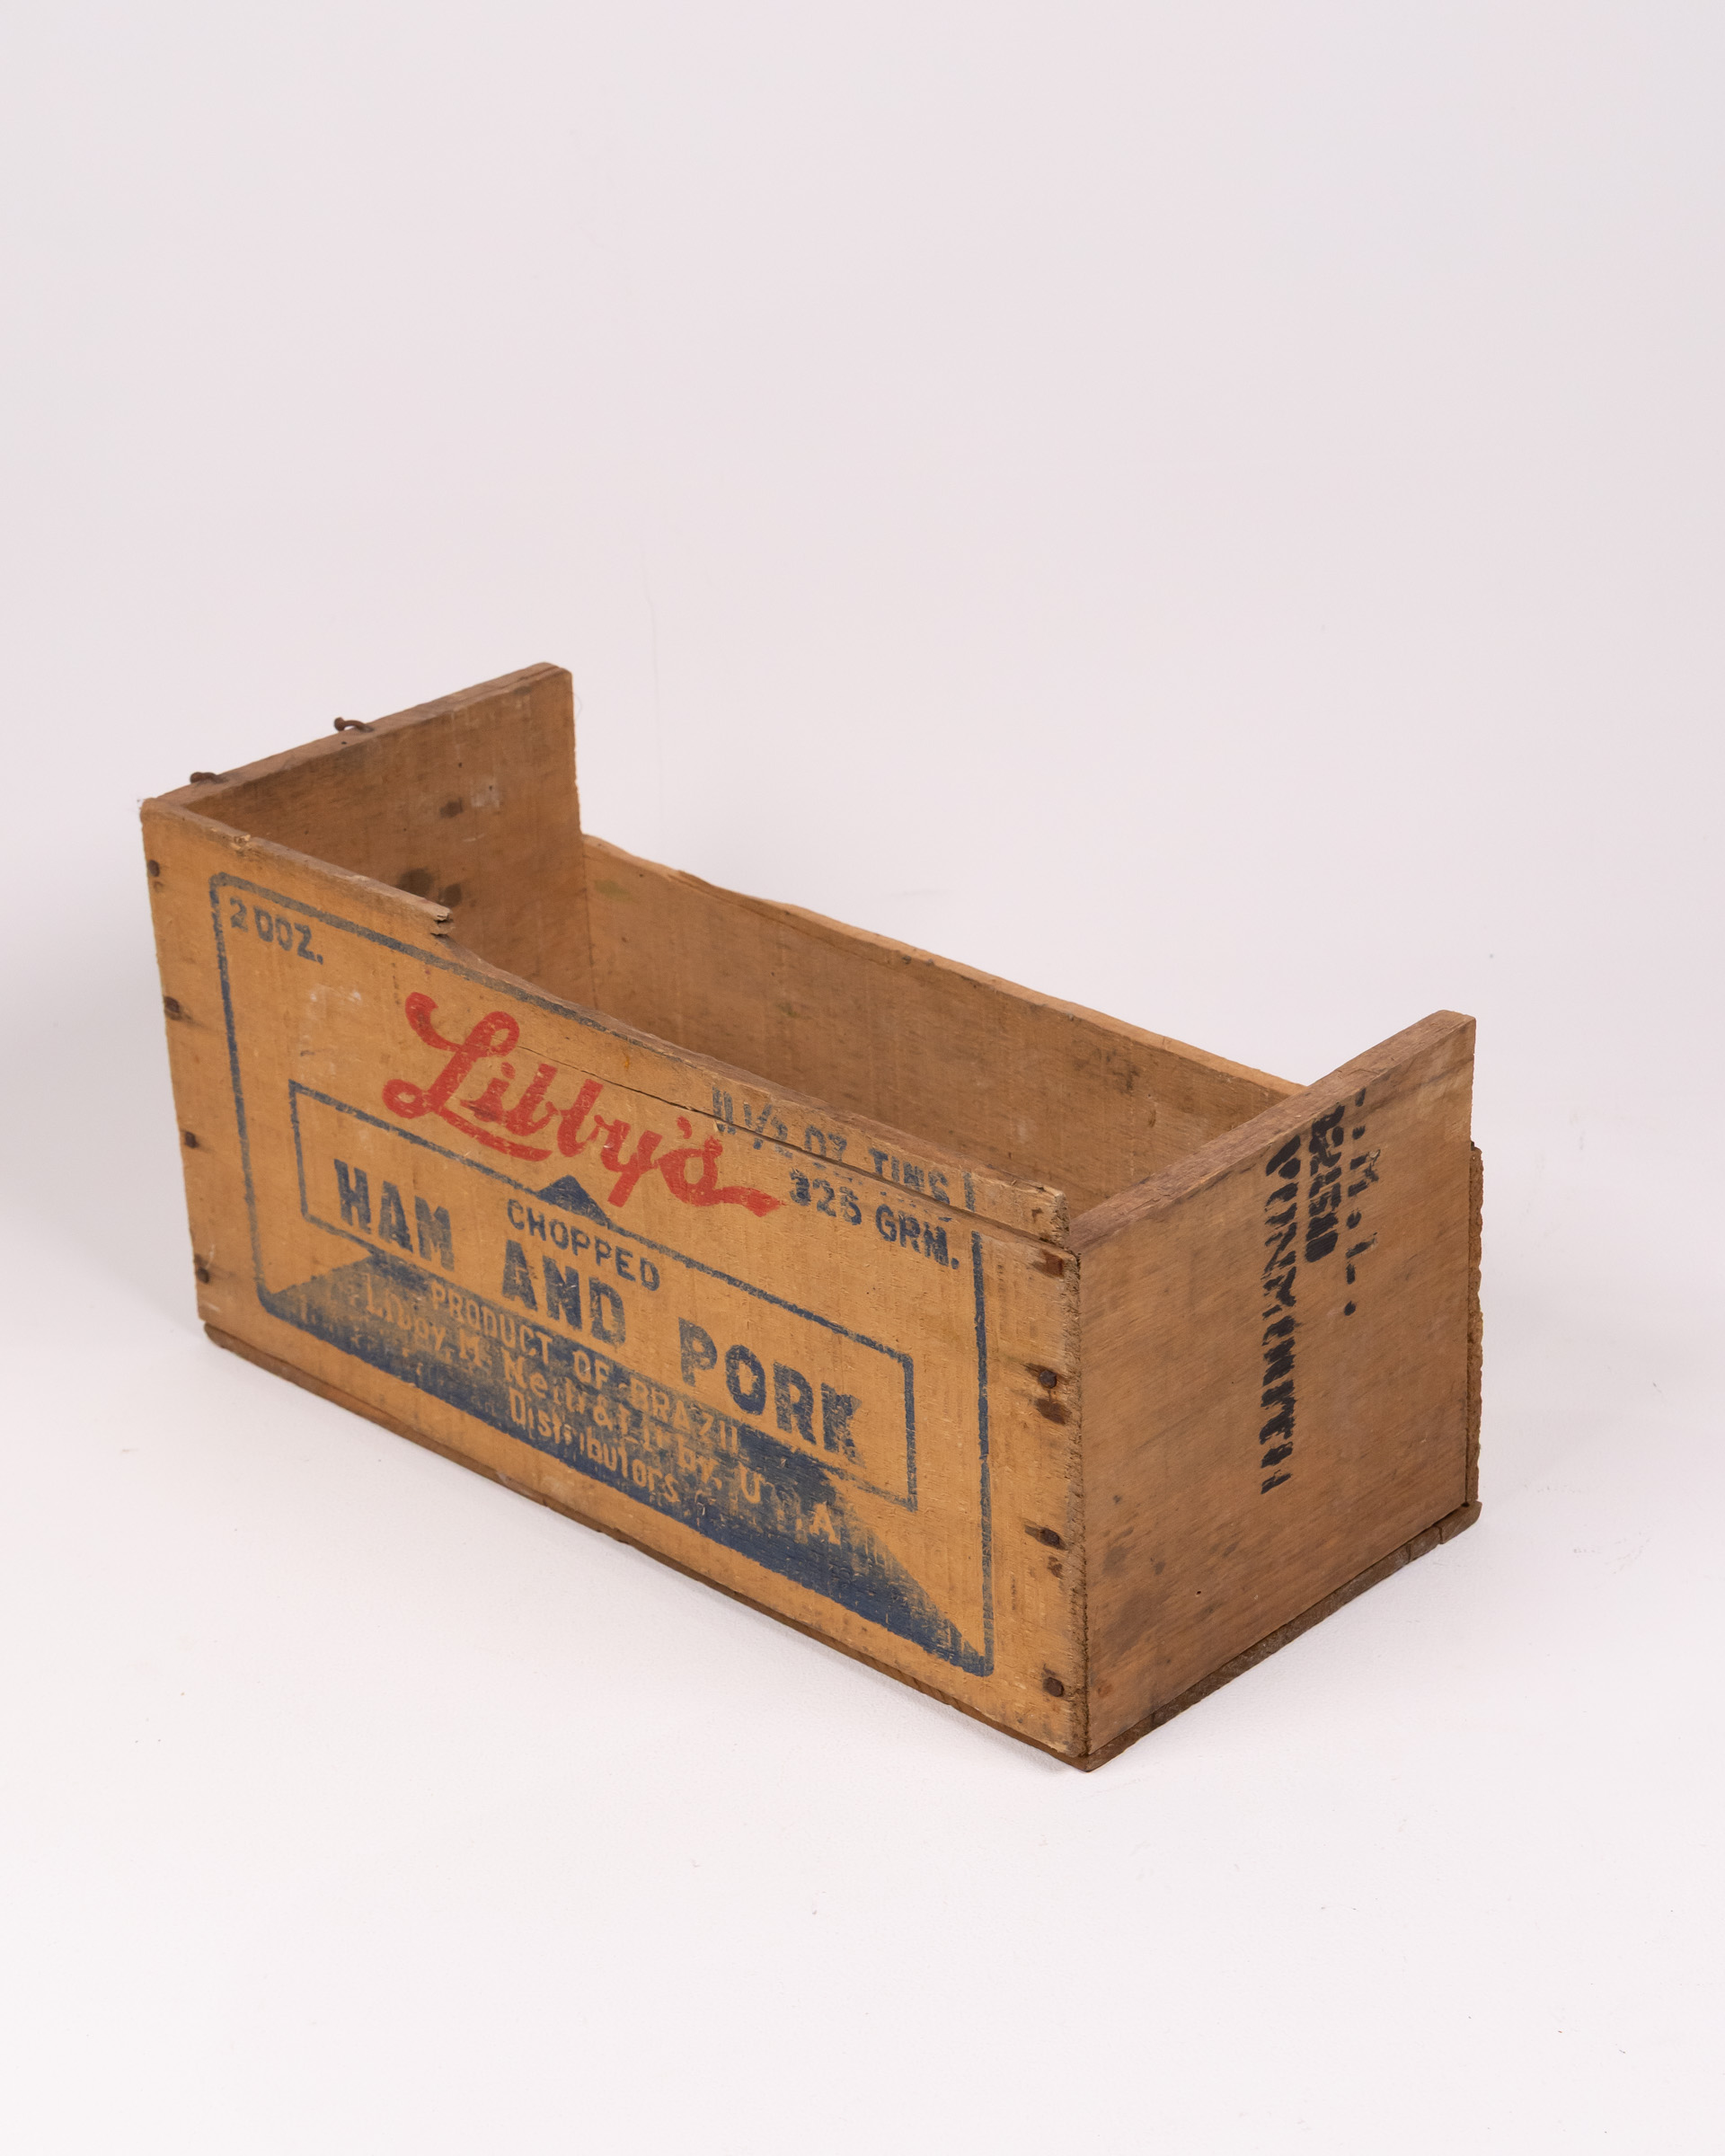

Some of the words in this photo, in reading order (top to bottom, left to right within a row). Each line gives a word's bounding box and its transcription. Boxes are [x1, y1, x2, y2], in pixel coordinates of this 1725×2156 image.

[229, 897, 249, 933] 2
[253, 905, 324, 966] DOZ.
[382, 992, 787, 1217] Libby's
[869, 1146, 952, 1223] TINS
[507, 1198, 660, 1291] CHOPPED
[334, 1158, 455, 1272] HAM
[501, 1239, 625, 1348] AND
[678, 1317, 864, 1469] PORK
[430, 1279, 553, 1365] PRODUCT
[573, 1349, 612, 1391] OF
